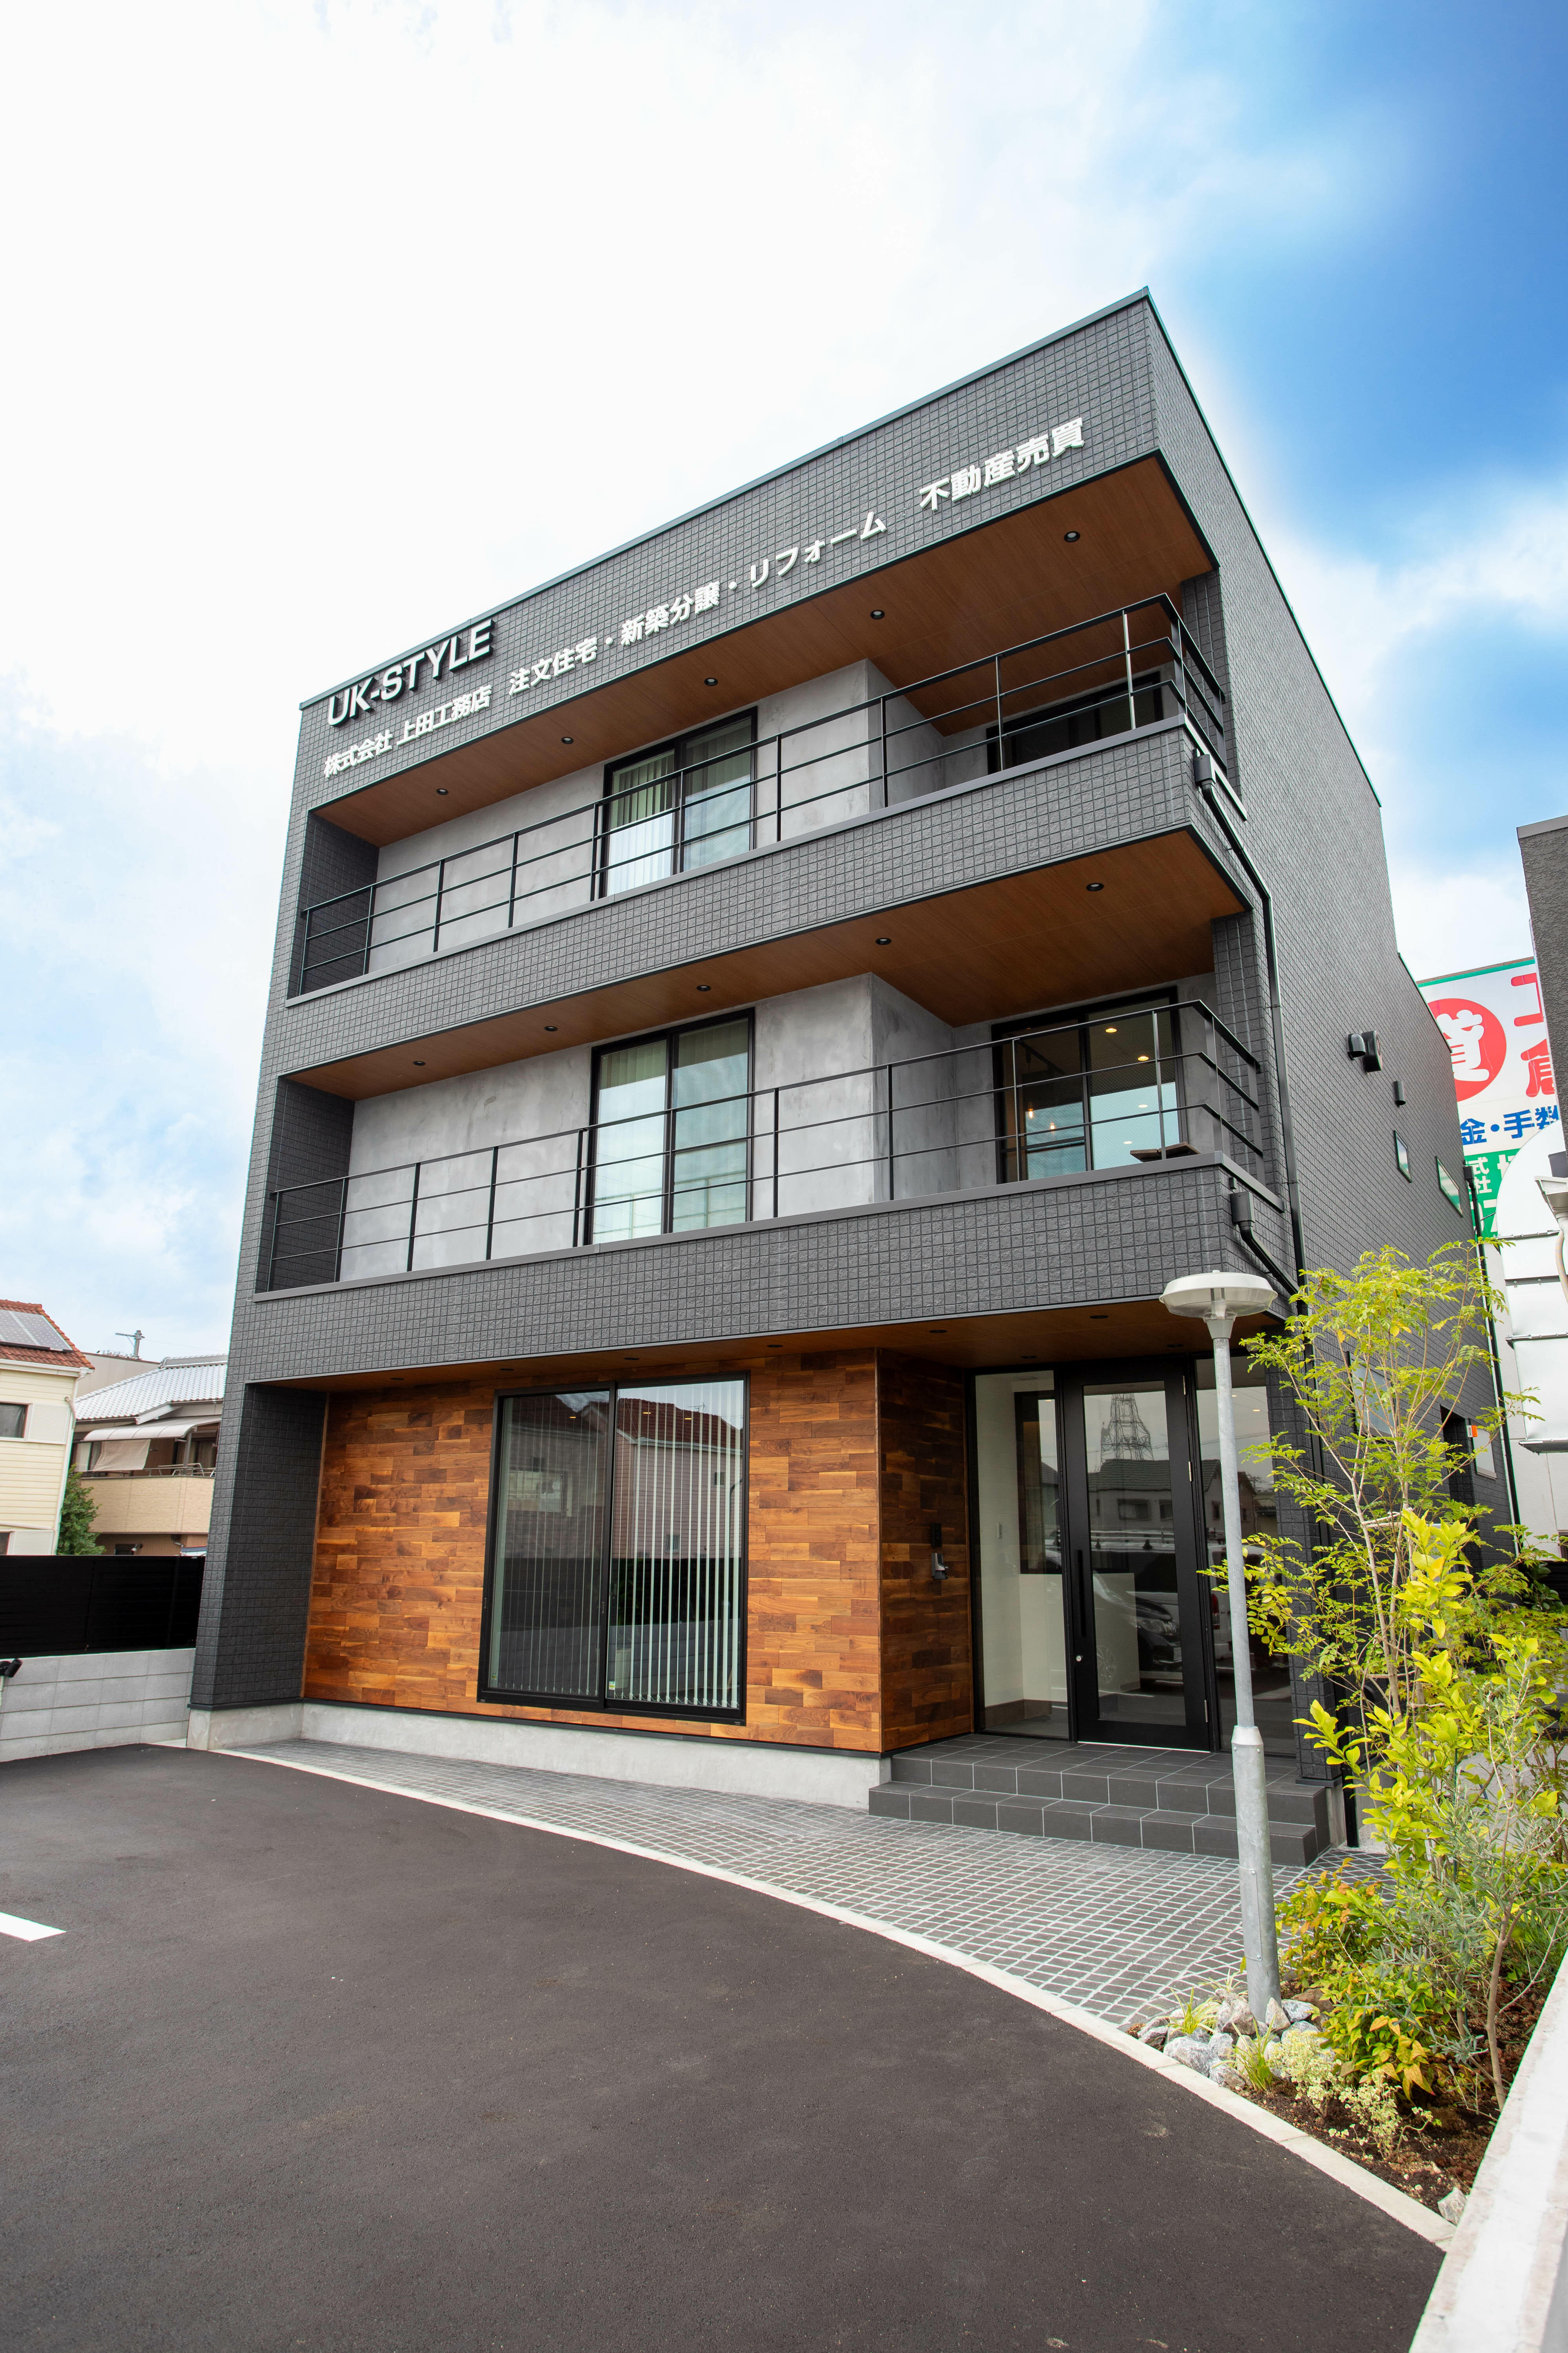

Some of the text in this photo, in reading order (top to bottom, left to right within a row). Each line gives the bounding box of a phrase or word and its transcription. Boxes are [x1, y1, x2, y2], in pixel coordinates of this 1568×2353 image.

[323, 729, 393, 778] 株式会社
[396, 684, 492, 746] 上田工務店
[919, 417, 1085, 511] 不動産売買
[327, 619, 495, 728] UK-STYLE
